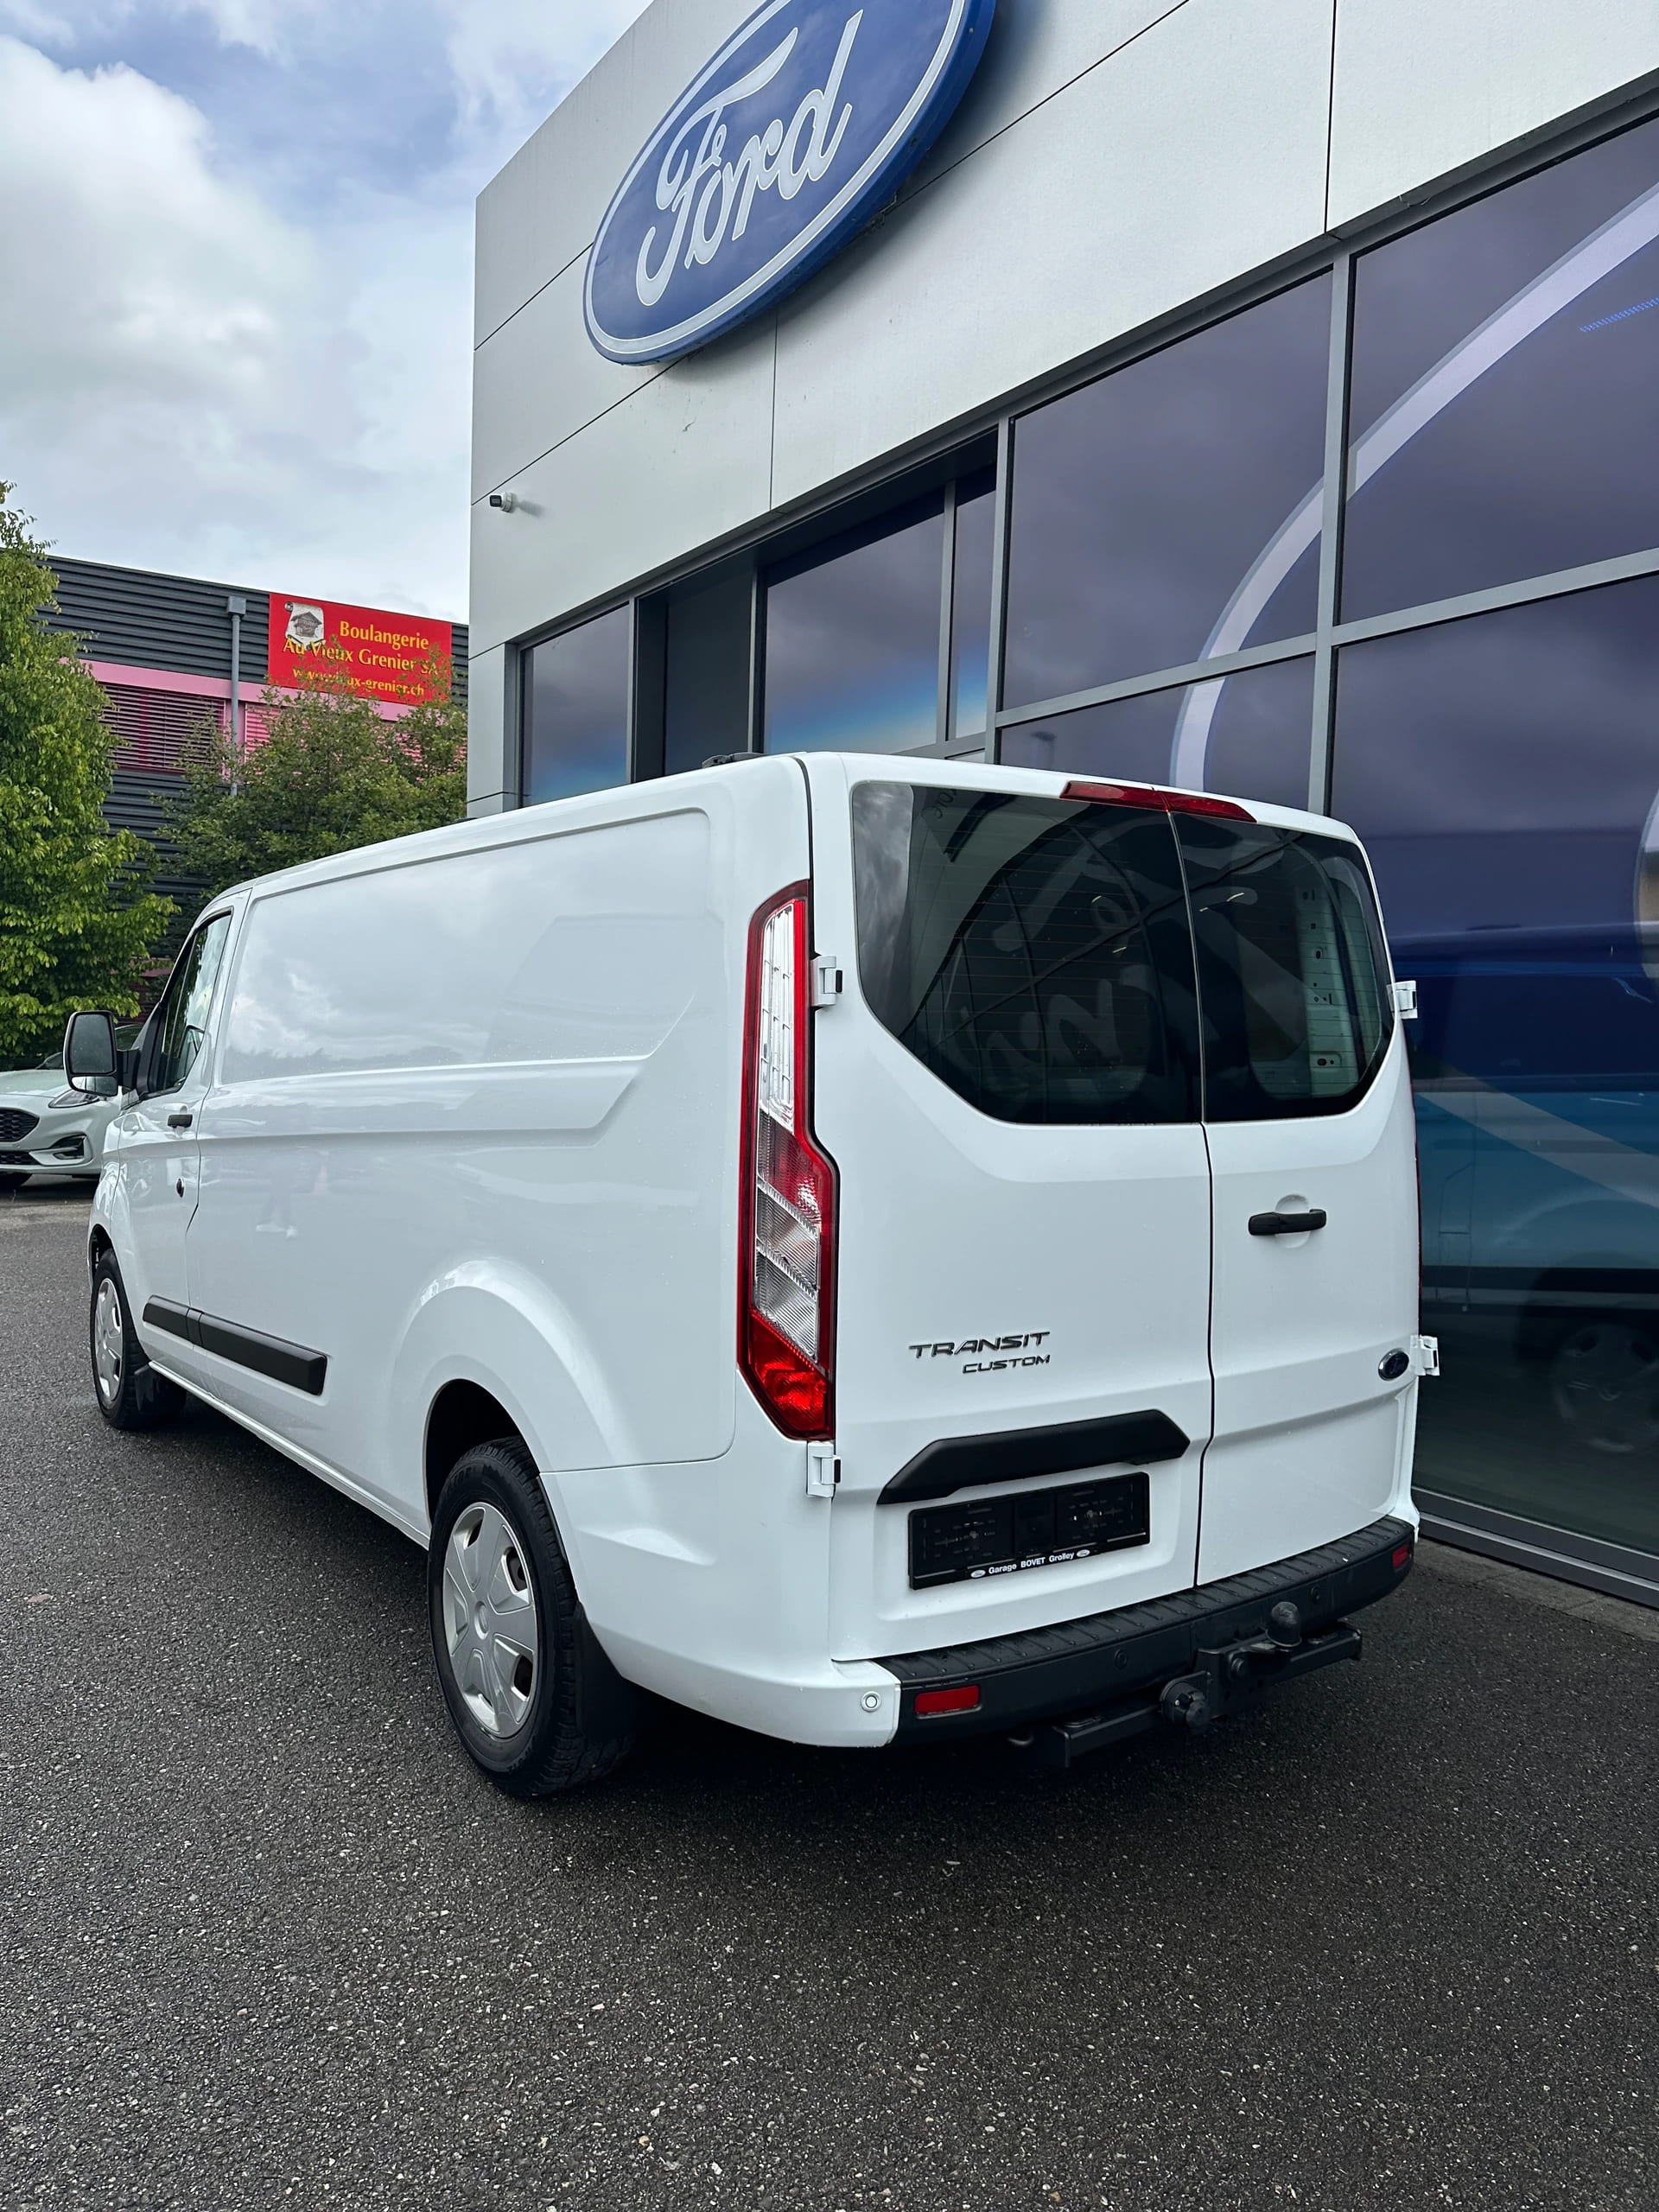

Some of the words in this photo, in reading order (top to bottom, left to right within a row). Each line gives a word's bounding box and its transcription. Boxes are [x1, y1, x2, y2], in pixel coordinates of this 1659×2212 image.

[635, 9, 863, 307] Ford
[340, 620, 429, 651] Boulangerie
[283, 638, 304, 655] Au
[311, 641, 353, 663] Vieux
[358, 648, 416, 671] Grenier
[908, 1331, 1051, 1359] TRANSIT
[962, 1354, 1051, 1374] CUSTOM
[988, 1563, 1017, 1574] Garage
[1020, 1556, 1046, 1568] BOVET
